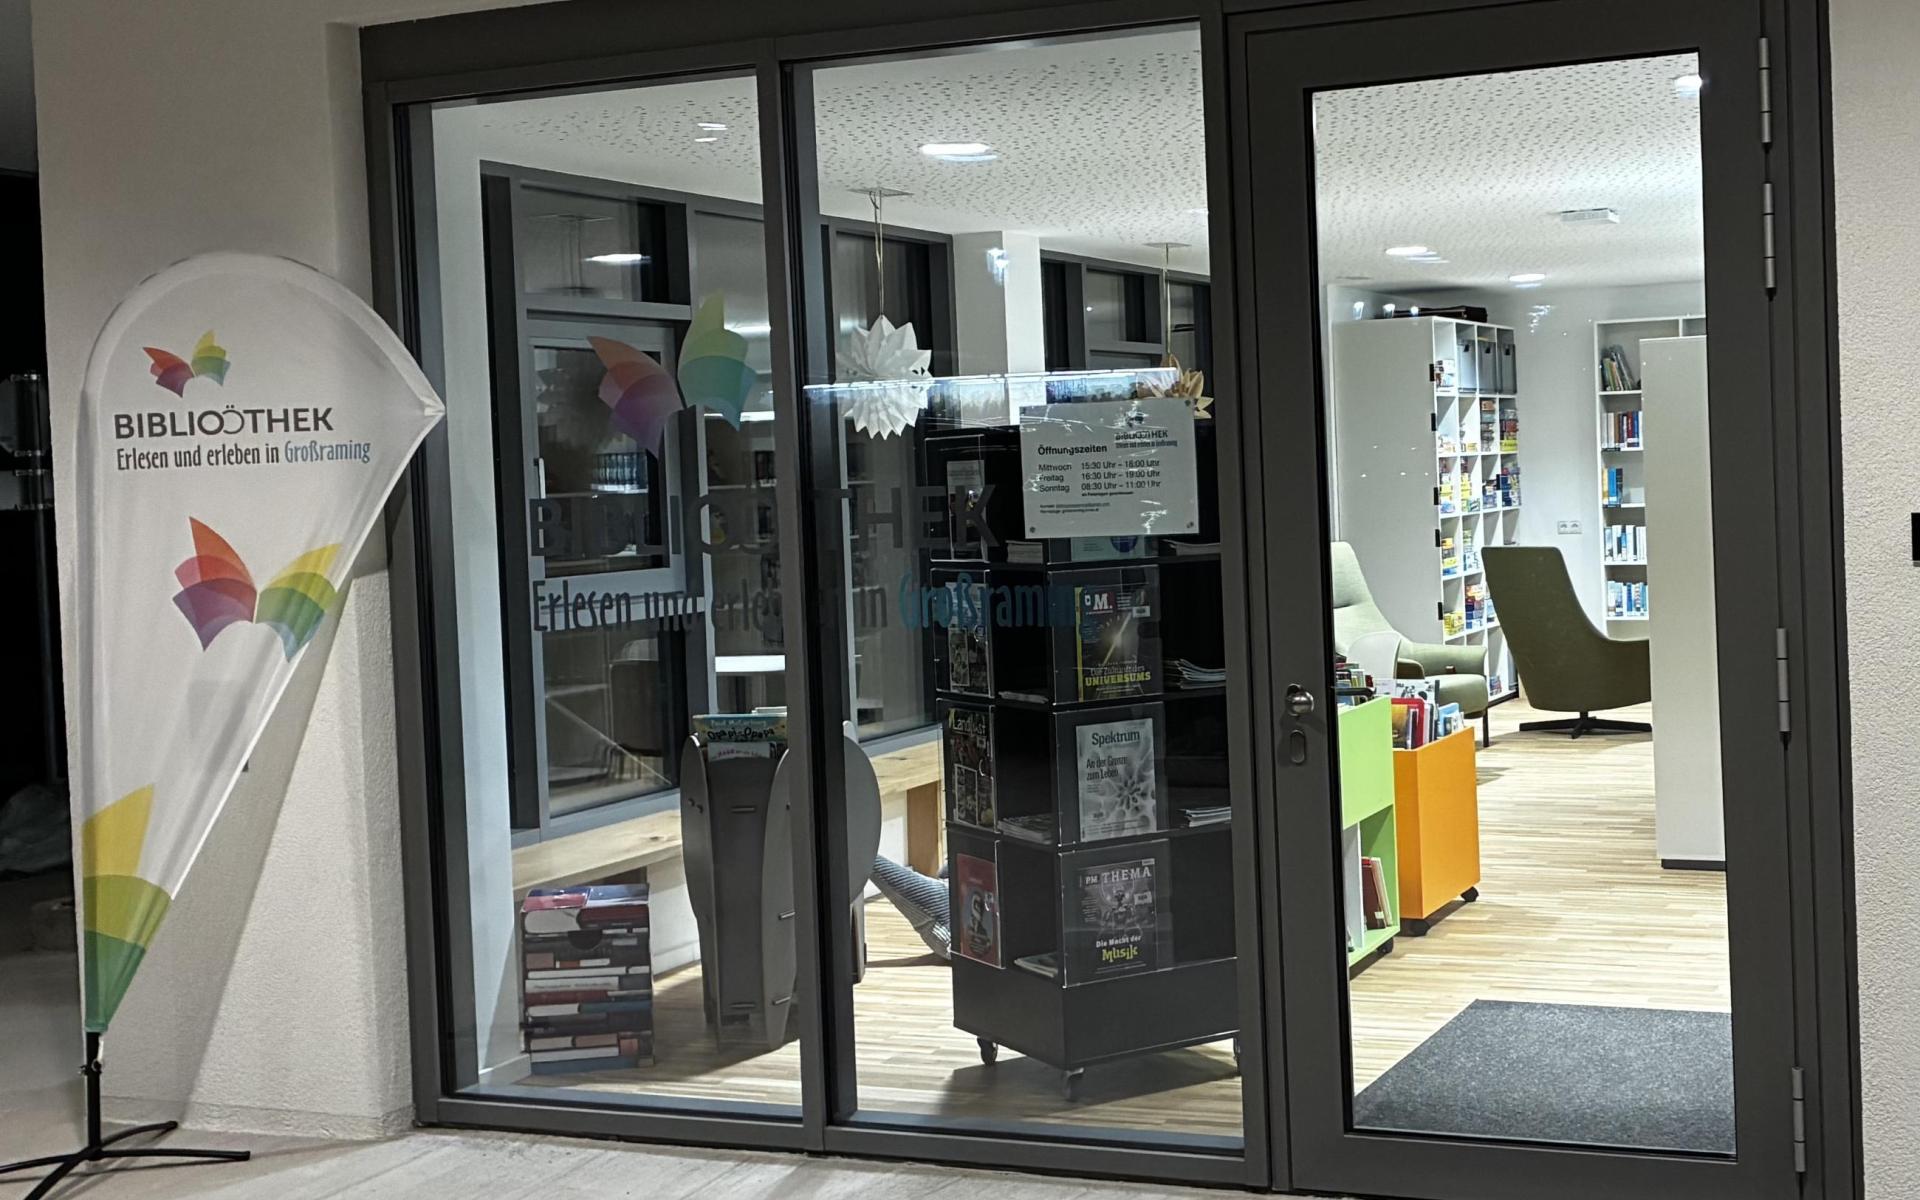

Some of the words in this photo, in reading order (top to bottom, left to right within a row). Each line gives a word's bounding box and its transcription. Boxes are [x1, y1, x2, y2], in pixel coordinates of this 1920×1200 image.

[117, 448, 169, 470] Erlesen
[174, 445, 201, 468] und
[207, 443, 261, 466] erleben
[266, 443, 280, 464] in
[285, 440, 371, 465] Großraming
[1038, 444, 1108, 456] Öffnungszeiten
[1038, 463, 1072, 472] Mittwoch
[1081, 461, 1101, 470] 15:30
[1103, 460, 1116, 469] Uhr
[1146, 459, 1160, 467] Uhr
[1081, 472, 1102, 480] 16:30
[1103, 471, 1117, 479] Uhr
[1125, 470, 1146, 478] 19:00
[1147, 470, 1161, 478] Uhr
[1040, 484, 1070, 493] Sonntag
[1104, 481, 1118, 490] Uhr
[1126, 481, 1146, 489] 11:00
[1147, 480, 1161, 488] Uhr
[532, 580, 632, 632] Erlesen
[900, 570, 1096, 641] Großram
[1084, 672, 1151, 687] UNIVERSUMS
[1091, 730, 1141, 748] Spektrum
[1101, 866, 1152, 884] THEMA
[1096, 940, 1108, 948] Die
[1102, 944, 1138, 963] Musik
